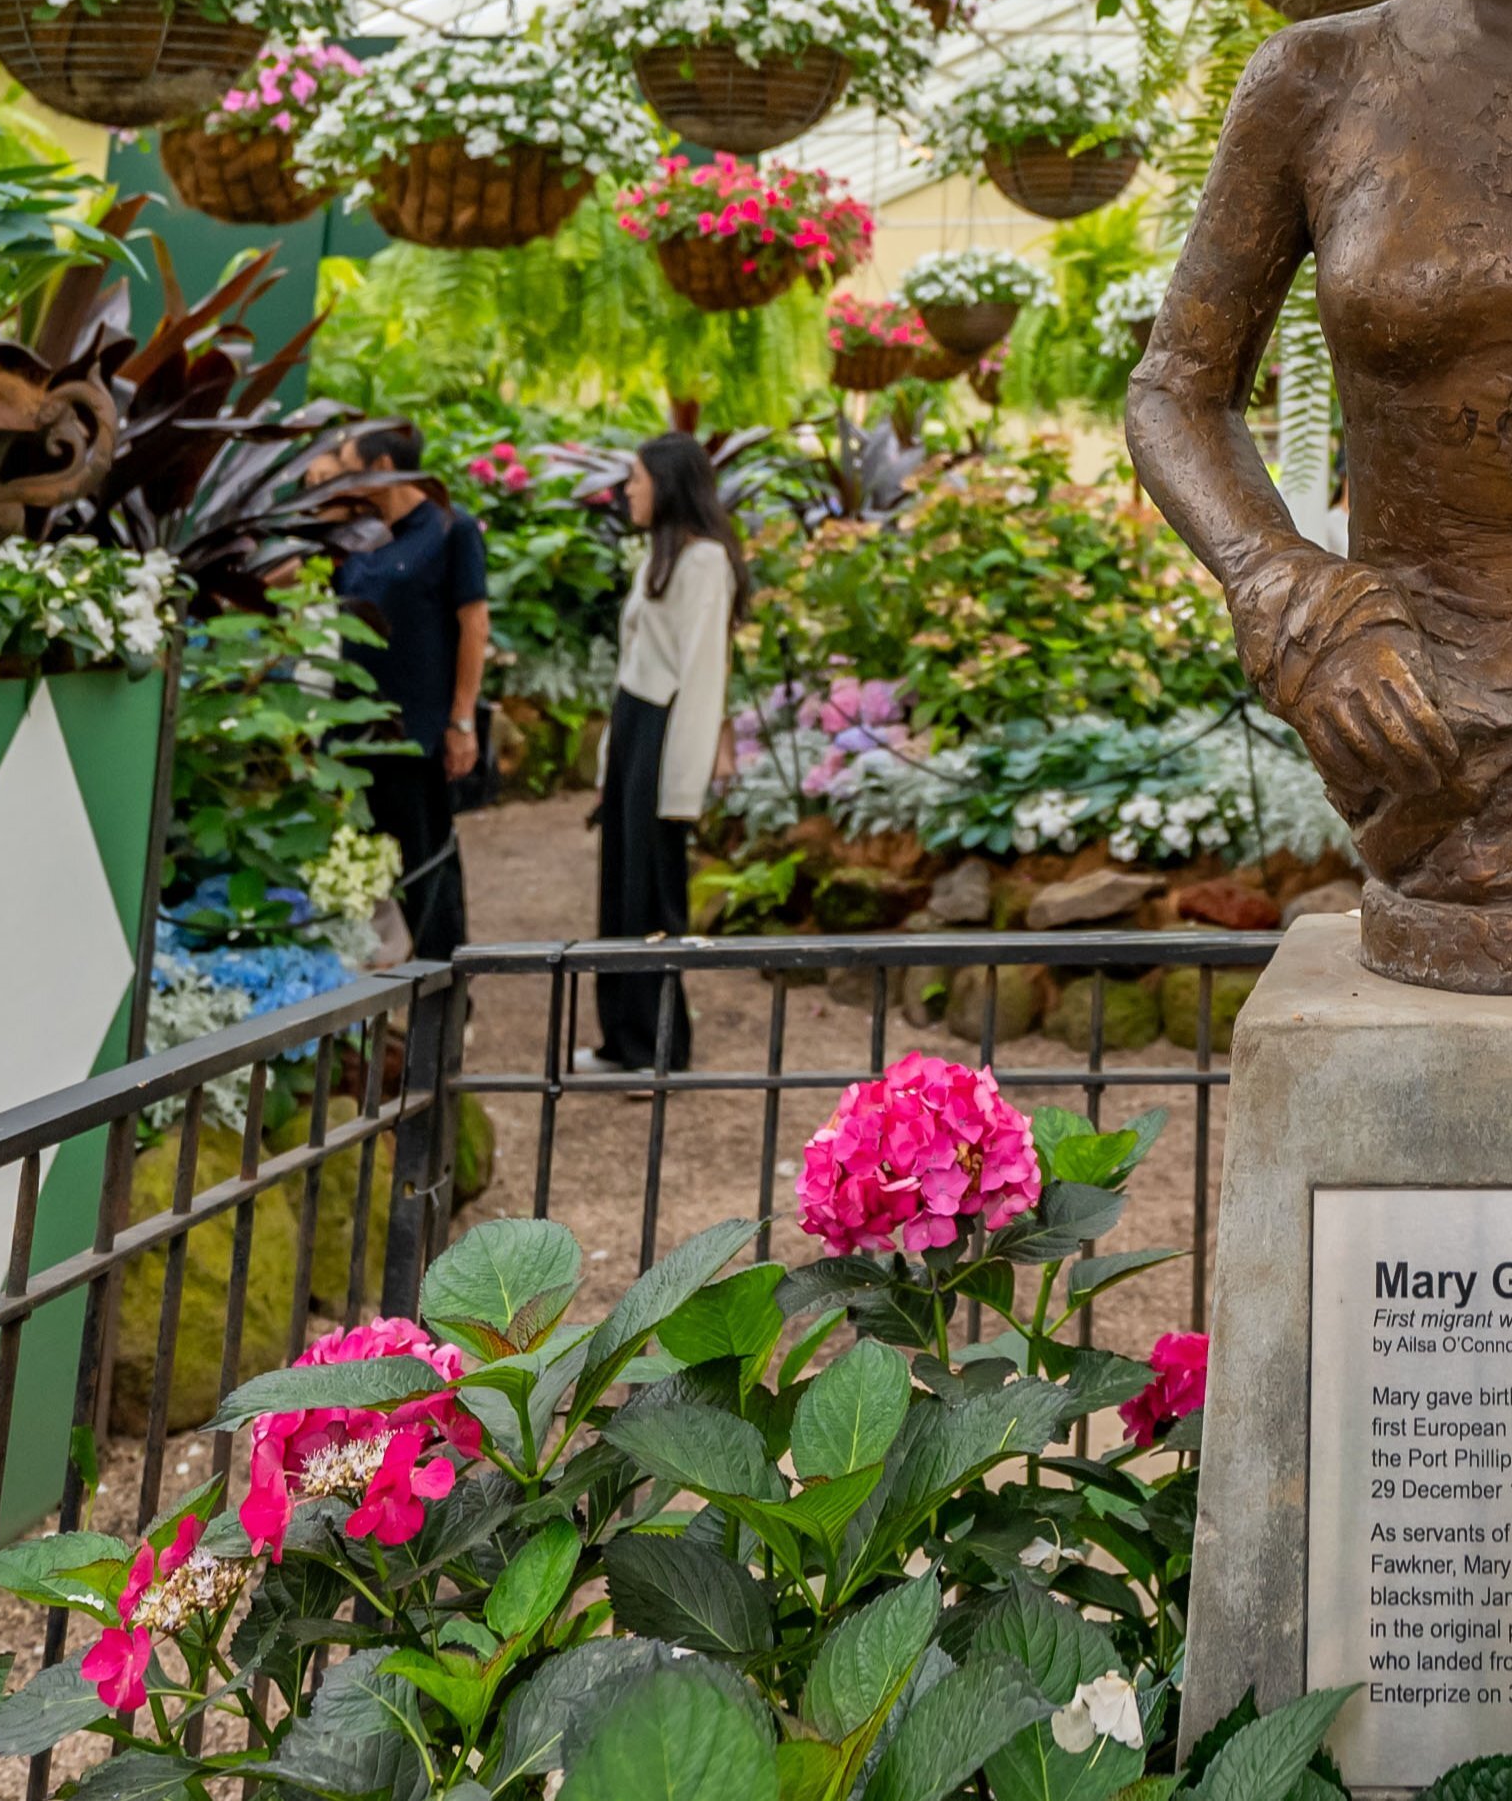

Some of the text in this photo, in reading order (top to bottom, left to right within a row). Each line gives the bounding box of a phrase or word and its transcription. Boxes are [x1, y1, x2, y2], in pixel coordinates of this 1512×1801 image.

[1375, 1261, 1478, 1308] Mary
[1373, 1309, 1416, 1328] First
[1420, 1307, 1494, 1332] migrant
[1372, 1336, 1393, 1356] by
[1395, 1336, 1437, 1353] Ailsa
[1372, 1386, 1421, 1410] Mary
[1426, 1391, 1473, 1410] gave
[1371, 1417, 1407, 1436] first
[1413, 1417, 1507, 1441] European
[1371, 1449, 1402, 1467] the
[1408, 1448, 1448, 1468] Port
[1454, 1449, 1512, 1472] Phillip
[1371, 1479, 1396, 1499] 29
[1402, 1479, 1504, 1499] December
[1370, 1523, 1397, 1542] As
[1402, 1524, 1486, 1542] servants
[1491, 1523, 1512, 1542] of
[1371, 1554, 1457, 1577] Fawkner,
[1464, 1555, 1512, 1579] Mary
[1370, 1586, 1474, 1606] blacksmith
[1370, 1618, 1387, 1638] in
[1392, 1618, 1424, 1638] the
[1430, 1619, 1501, 1643] original
[1369, 1651, 1411, 1670] who
[1416, 1651, 1483, 1671] landed
[1369, 1683, 1471, 1708] Enterprize
[1477, 1688, 1502, 1703] on
